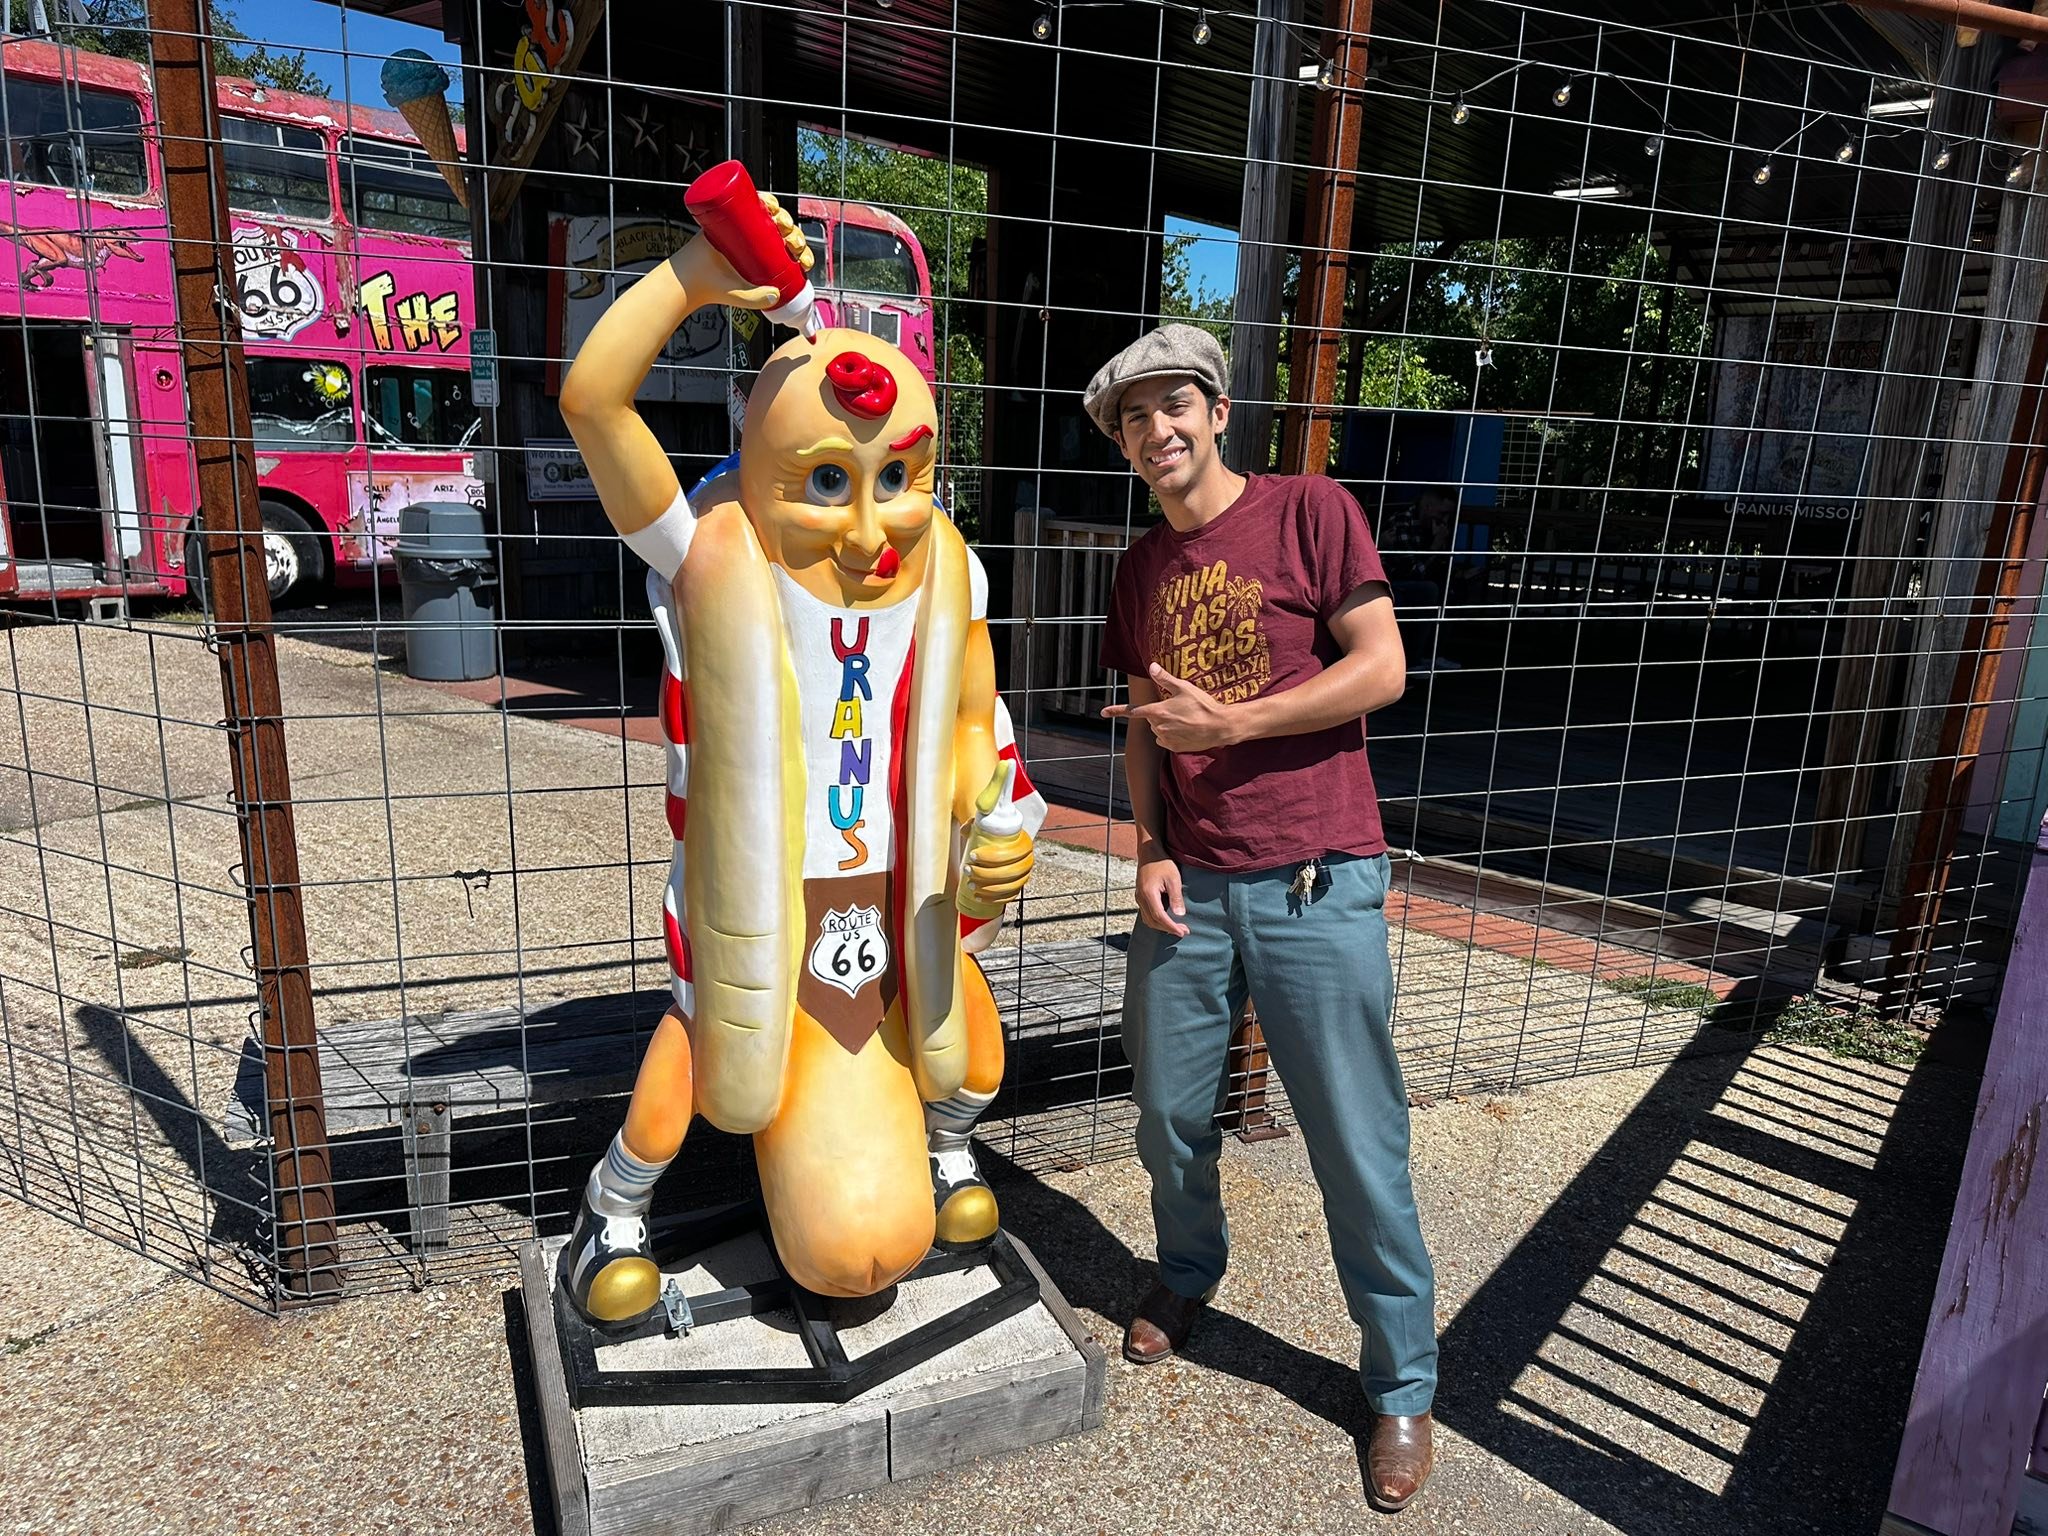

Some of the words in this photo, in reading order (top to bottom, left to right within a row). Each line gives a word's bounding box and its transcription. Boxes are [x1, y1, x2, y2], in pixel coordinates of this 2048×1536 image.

[237, 264, 302, 318] 66
[1165, 559, 1228, 615] VIVA
[1173, 594, 1227, 646] LAS
[1164, 618, 1257, 680] VEGAS
[829, 617, 872, 871] URANUS
[829, 913, 872, 931] ROUTE
[842, 930, 861, 942] US
[831, 938, 876, 976] 66
